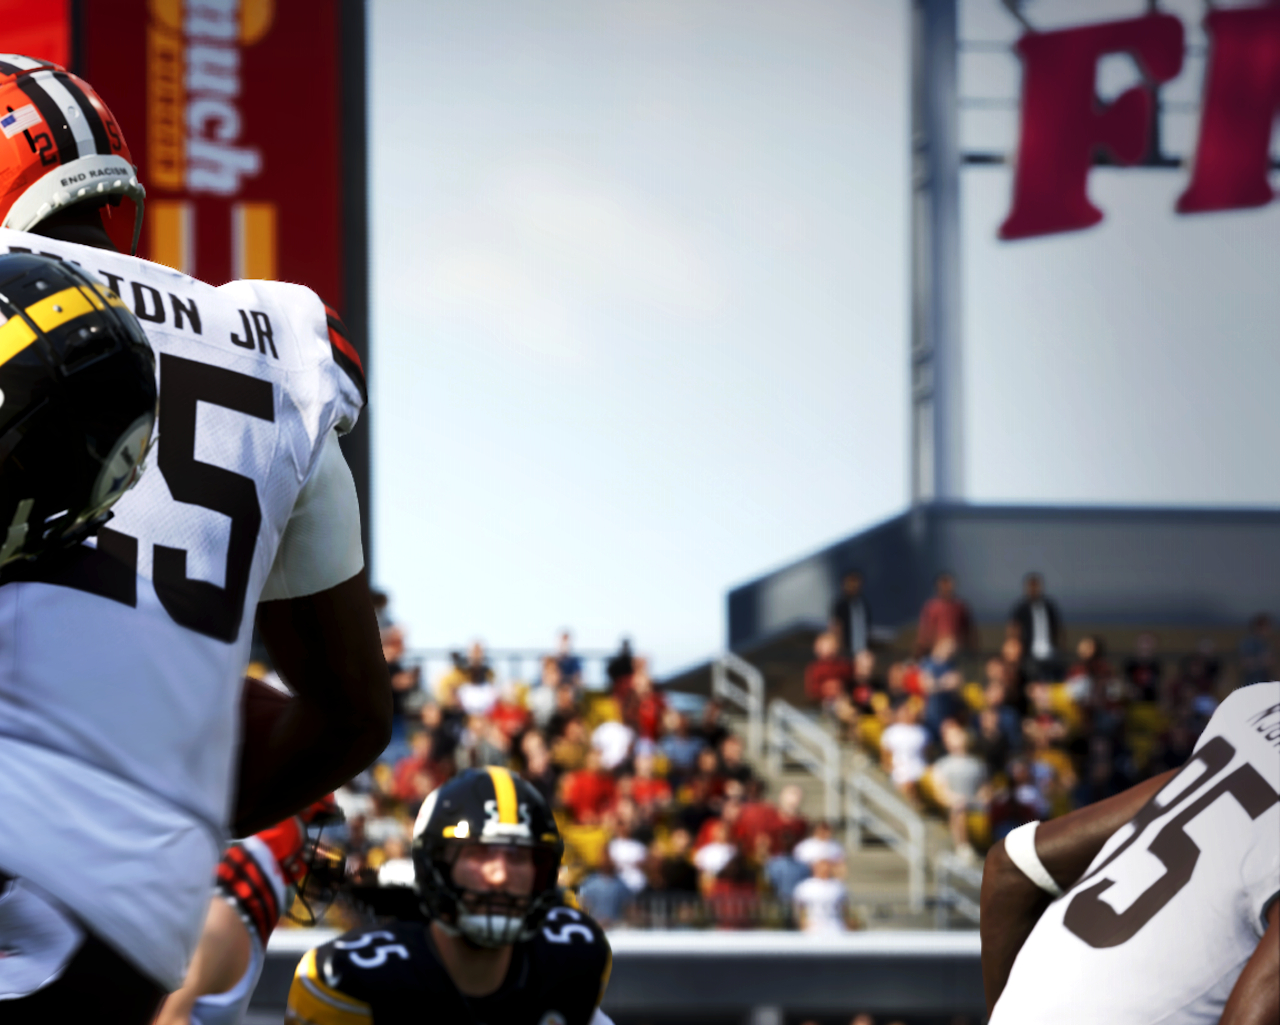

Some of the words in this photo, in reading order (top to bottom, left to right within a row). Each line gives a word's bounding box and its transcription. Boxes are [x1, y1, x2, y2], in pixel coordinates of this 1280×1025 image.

[34, 132, 58, 167] 2
[60, 172, 87, 188] END
[89, 166, 130, 179] RACISM
[230, 308, 280, 361] JR
[1063, 735, 1280, 949] 85
